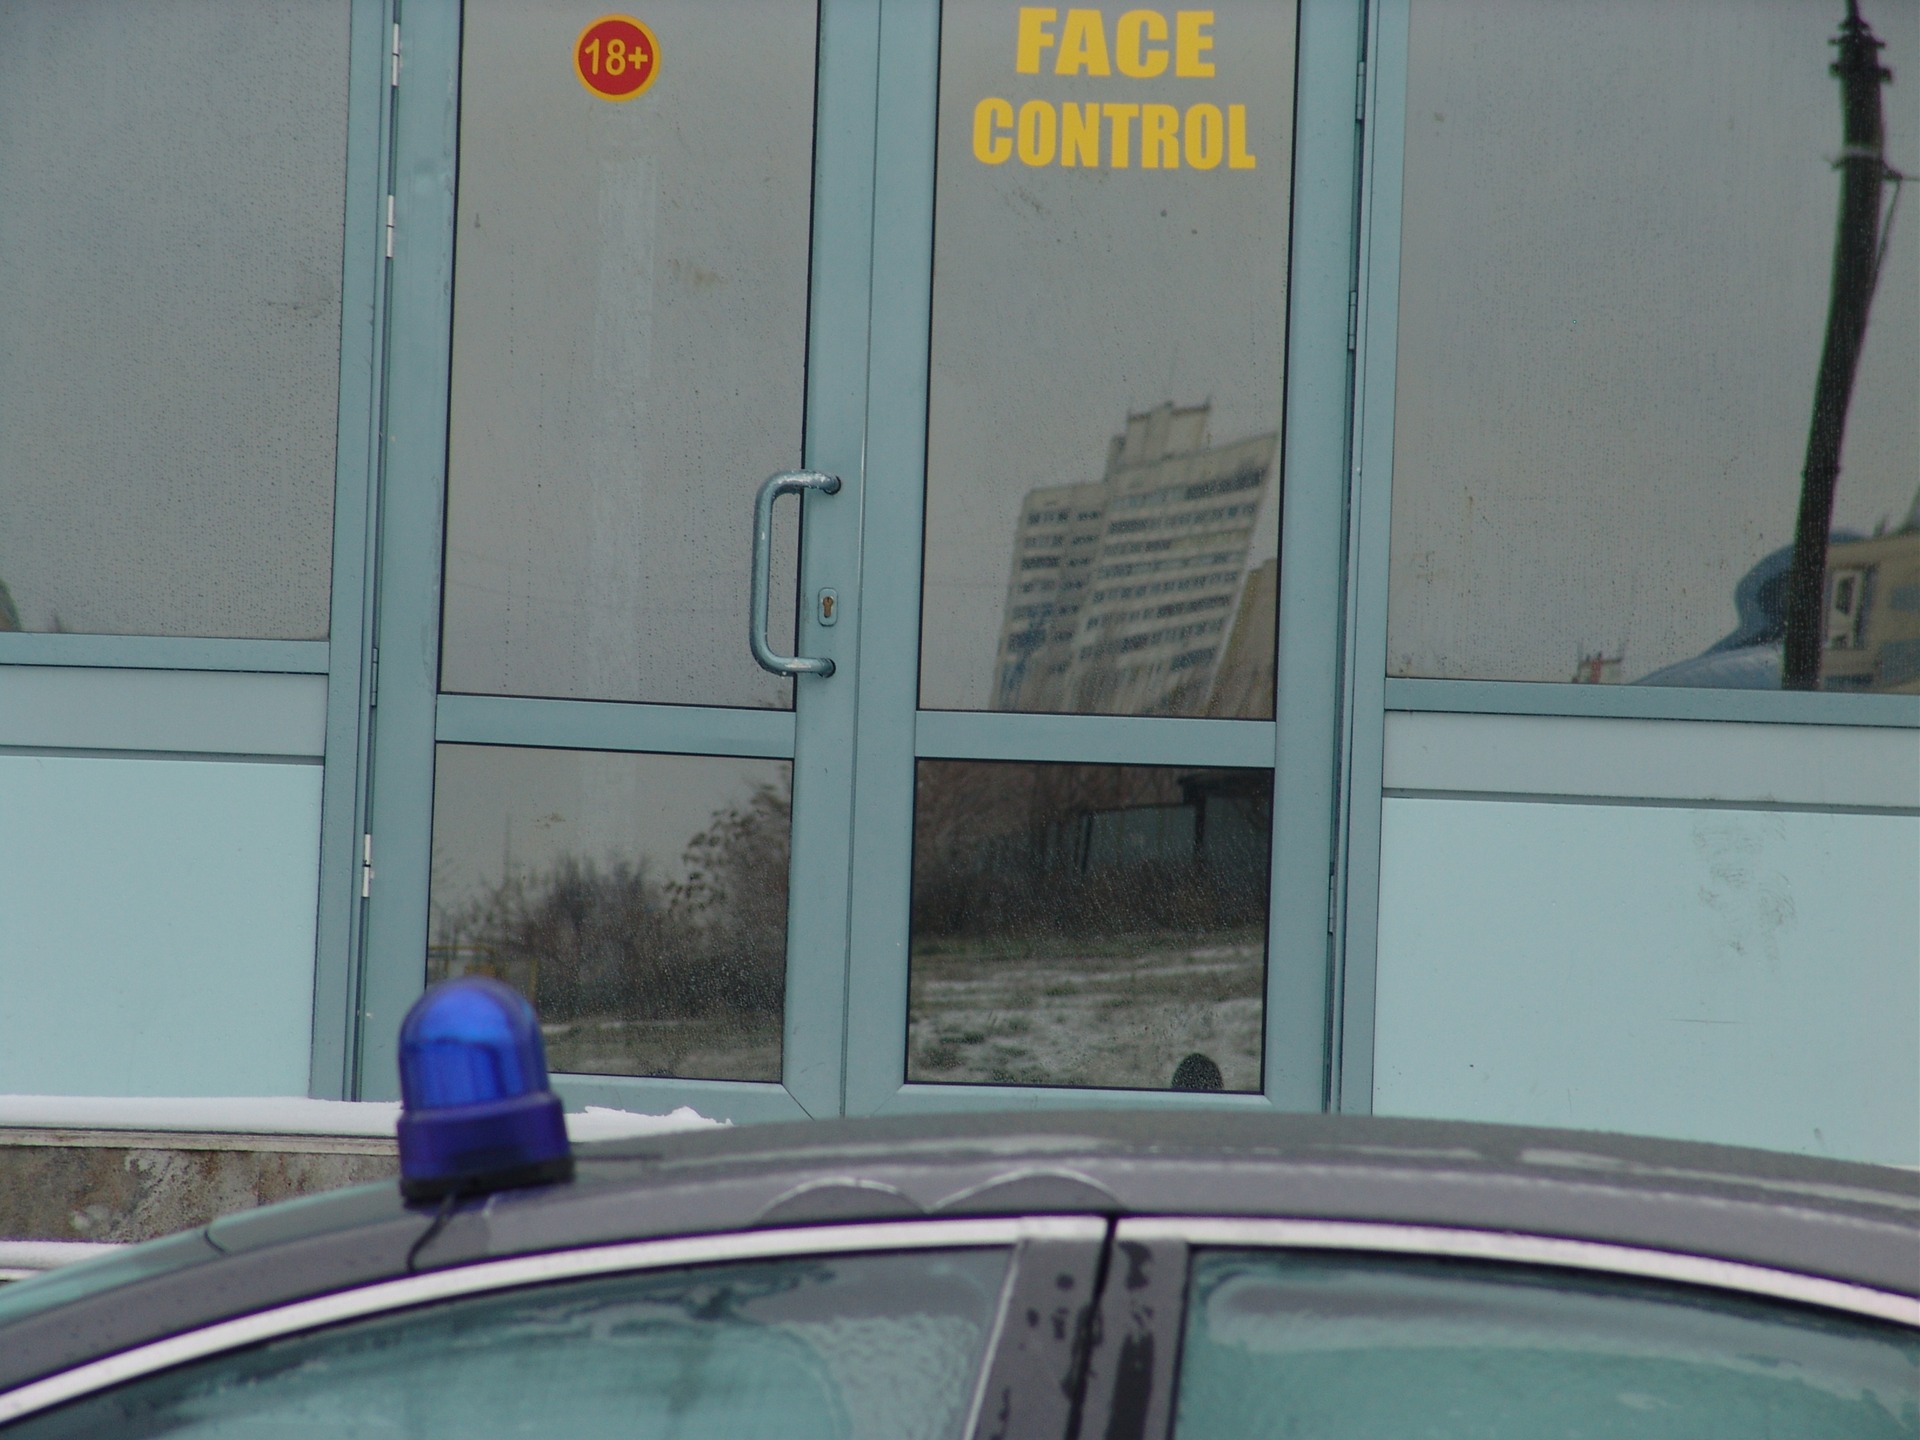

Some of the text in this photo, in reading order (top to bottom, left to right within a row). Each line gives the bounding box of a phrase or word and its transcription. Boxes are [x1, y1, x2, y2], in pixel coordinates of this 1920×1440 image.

[583, 38, 650, 76] 18+
[1015, 7, 1217, 79] FACE
[971, 97, 1257, 171] CONTROL
